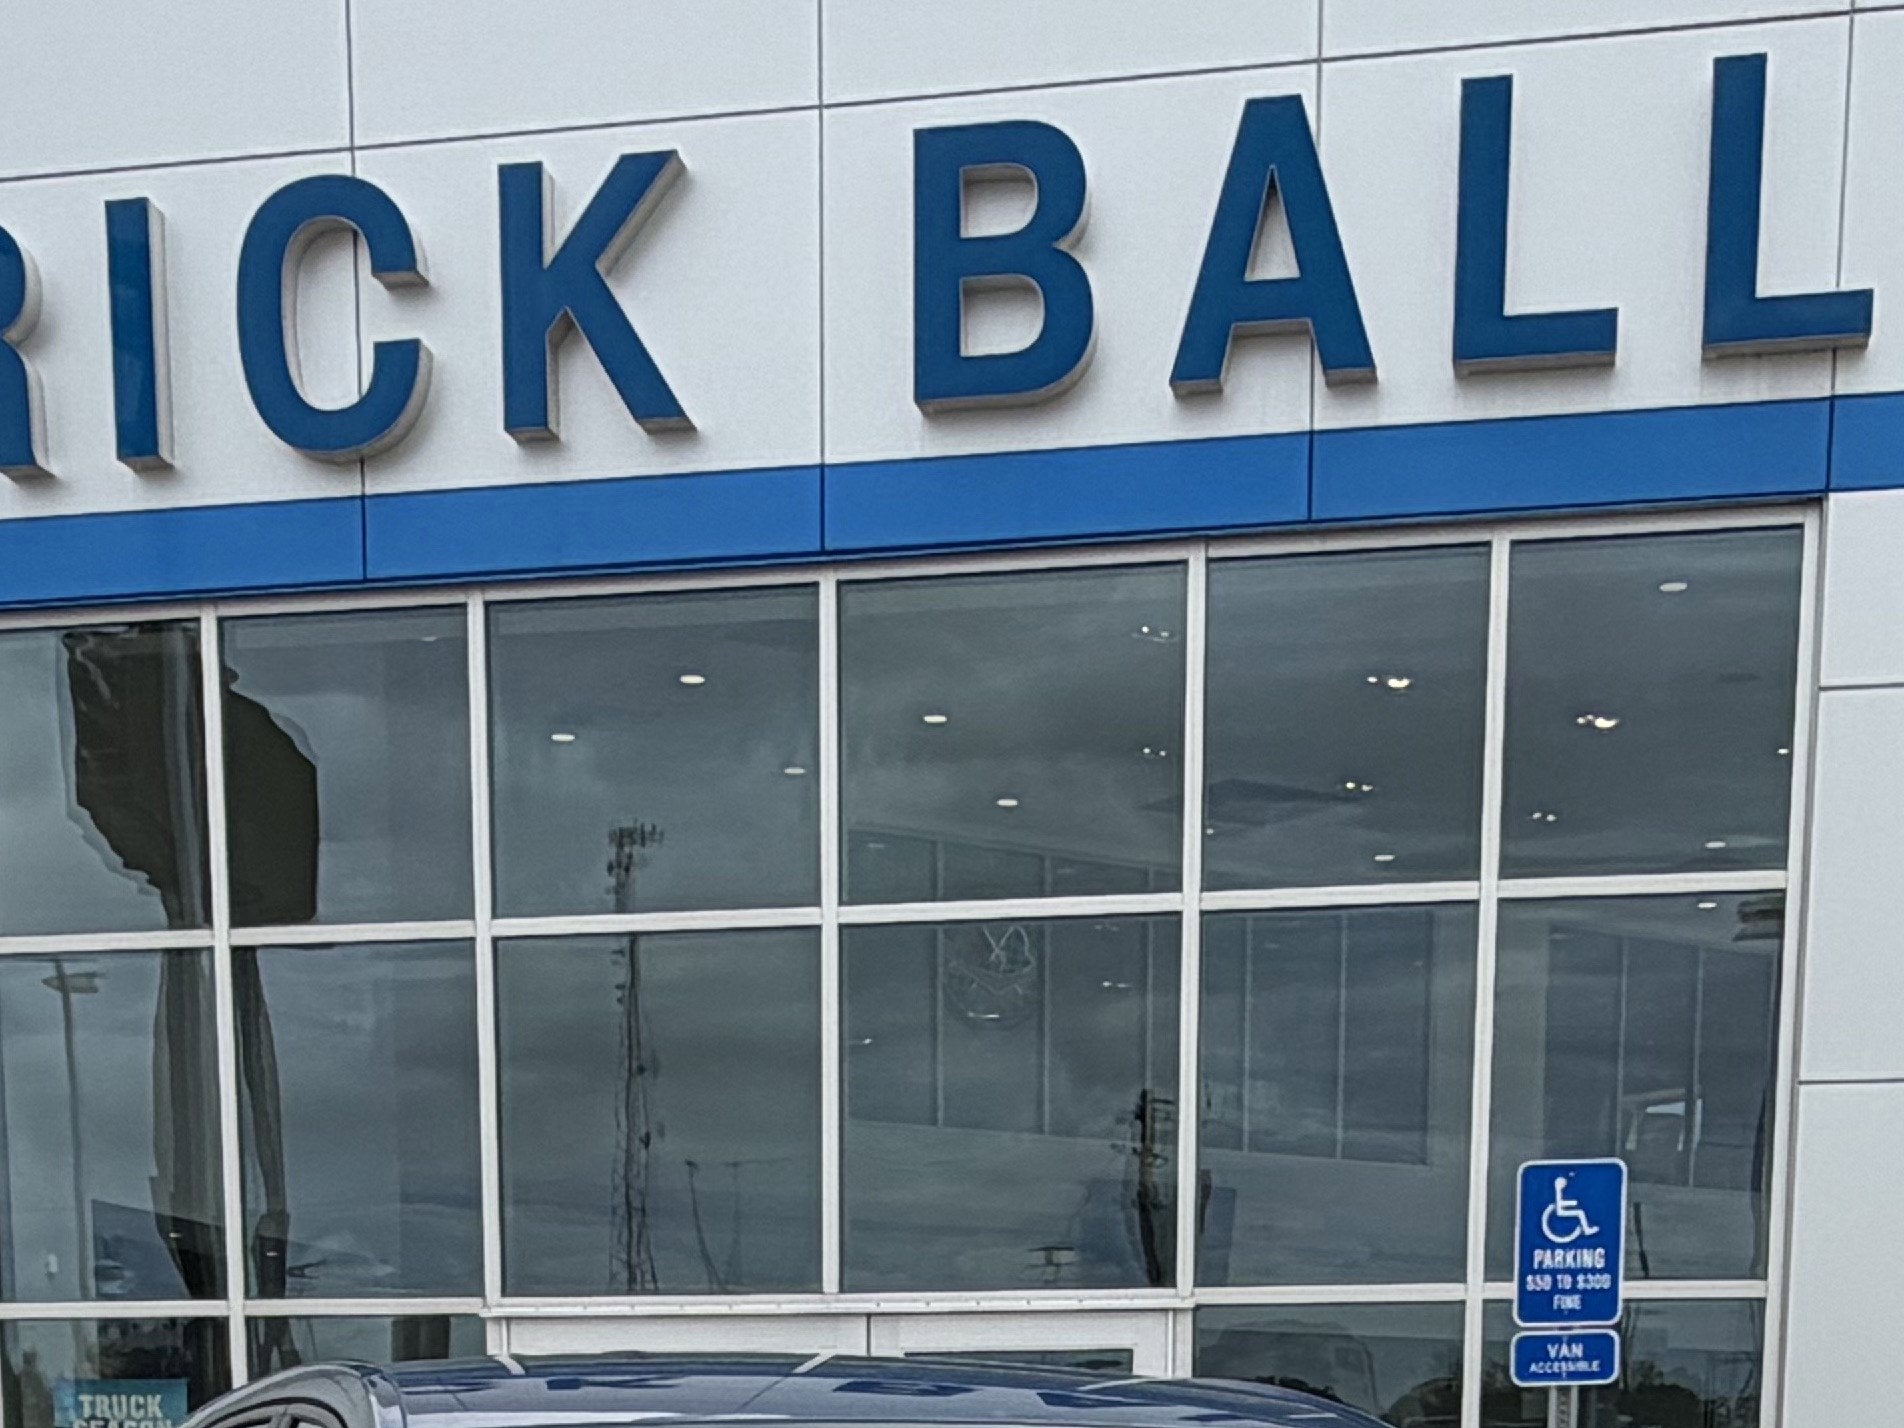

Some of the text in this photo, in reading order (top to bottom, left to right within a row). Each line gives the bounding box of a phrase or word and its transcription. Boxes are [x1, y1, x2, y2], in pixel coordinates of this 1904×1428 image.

[913, 53, 1874, 413] BALL
[1533, 1247, 1606, 1269] PARKING
[1547, 1343, 1583, 1359] VAN
[78, 1394, 163, 1420] TRUCK
